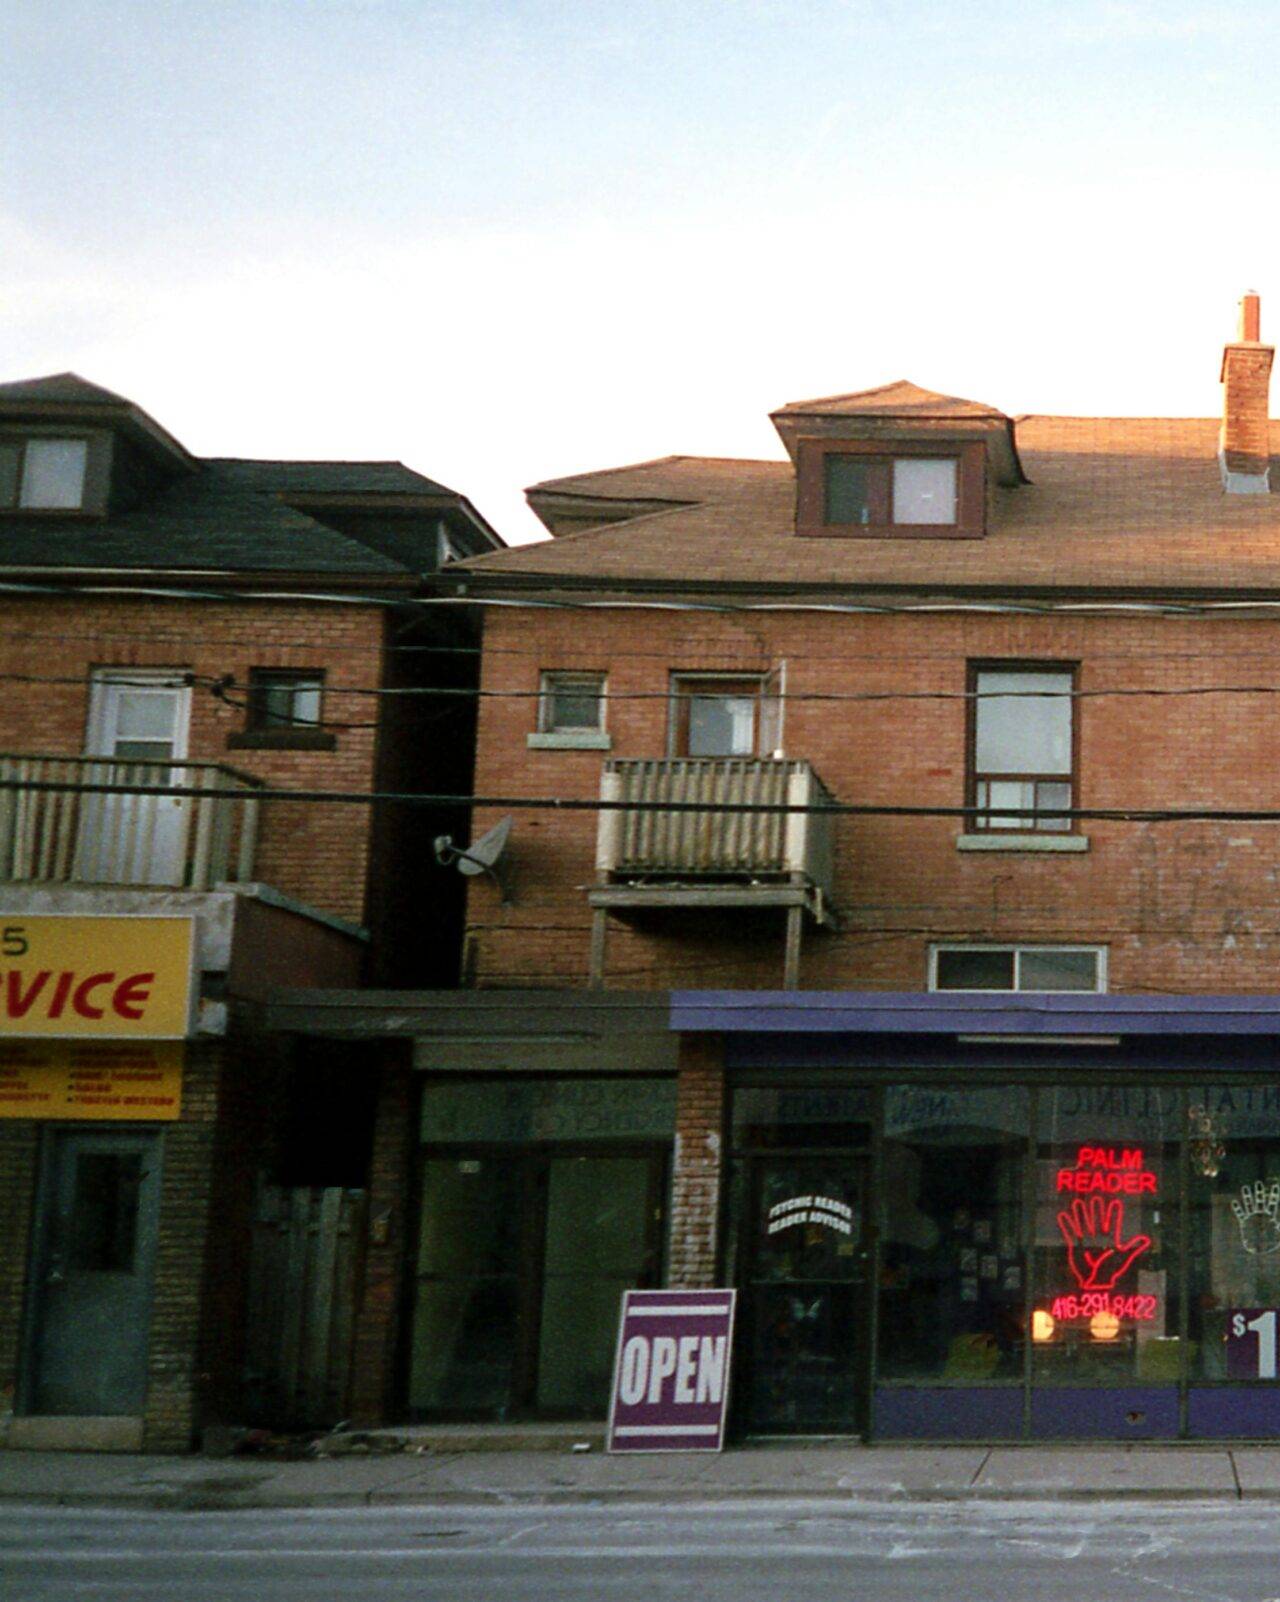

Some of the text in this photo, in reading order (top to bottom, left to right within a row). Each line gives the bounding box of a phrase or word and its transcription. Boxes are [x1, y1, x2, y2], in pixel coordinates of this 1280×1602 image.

[2, 926, 28, 956] 5
[0, 970, 155, 1019] VICE
[1078, 1147, 1142, 1170] PALM
[1056, 1169, 1156, 1194] READER
[769, 1195, 852, 1219] PSYCHIC READER
[619, 1335, 727, 1405] OPEN
